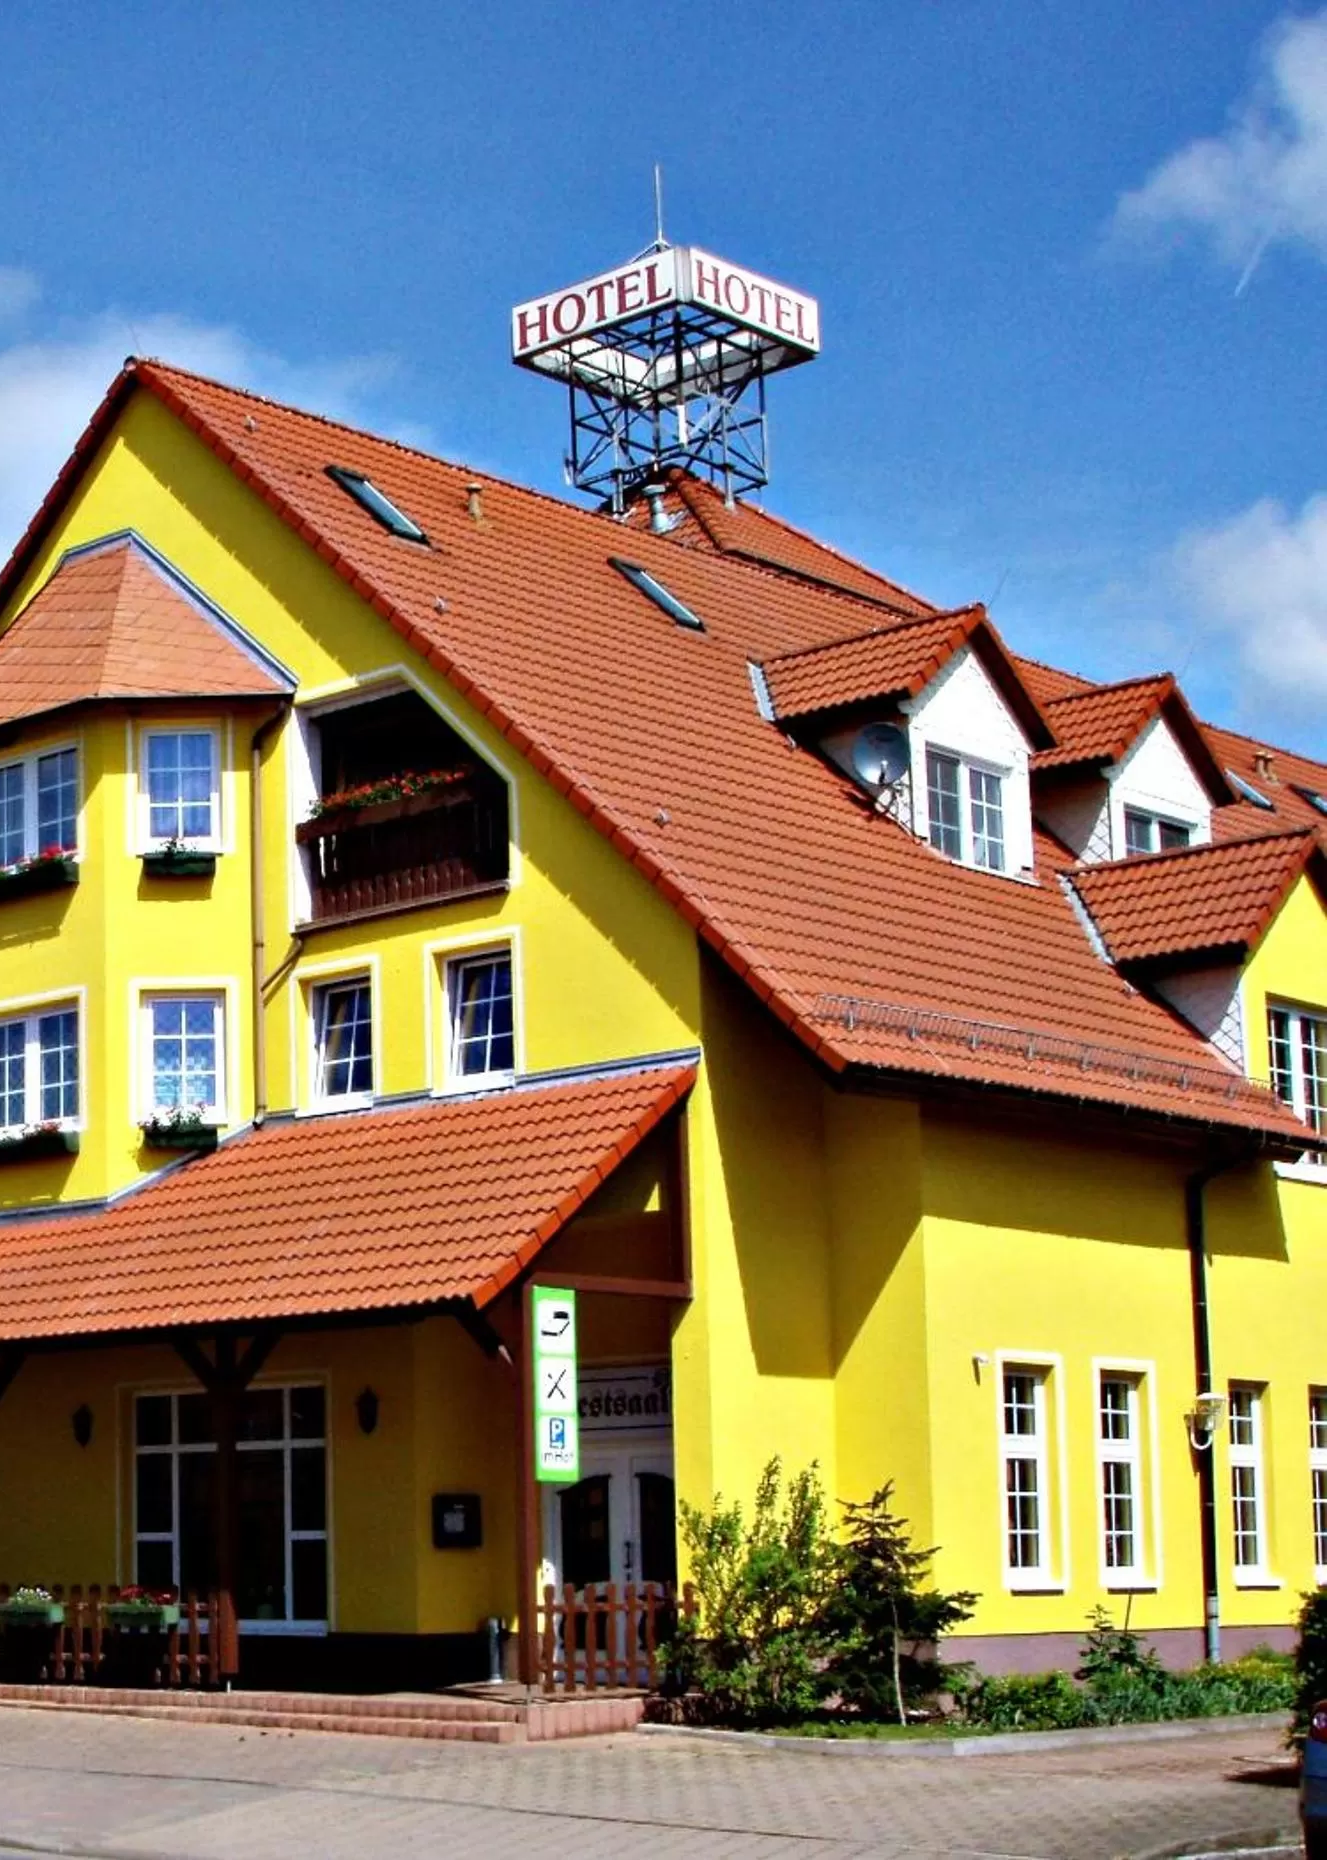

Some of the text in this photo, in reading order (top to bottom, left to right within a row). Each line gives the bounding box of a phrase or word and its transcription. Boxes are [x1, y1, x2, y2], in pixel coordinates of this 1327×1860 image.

[517, 262, 672, 351] HOTEL
[696, 260, 814, 344] HOTEL
[577, 1386, 670, 1417] estsaal
